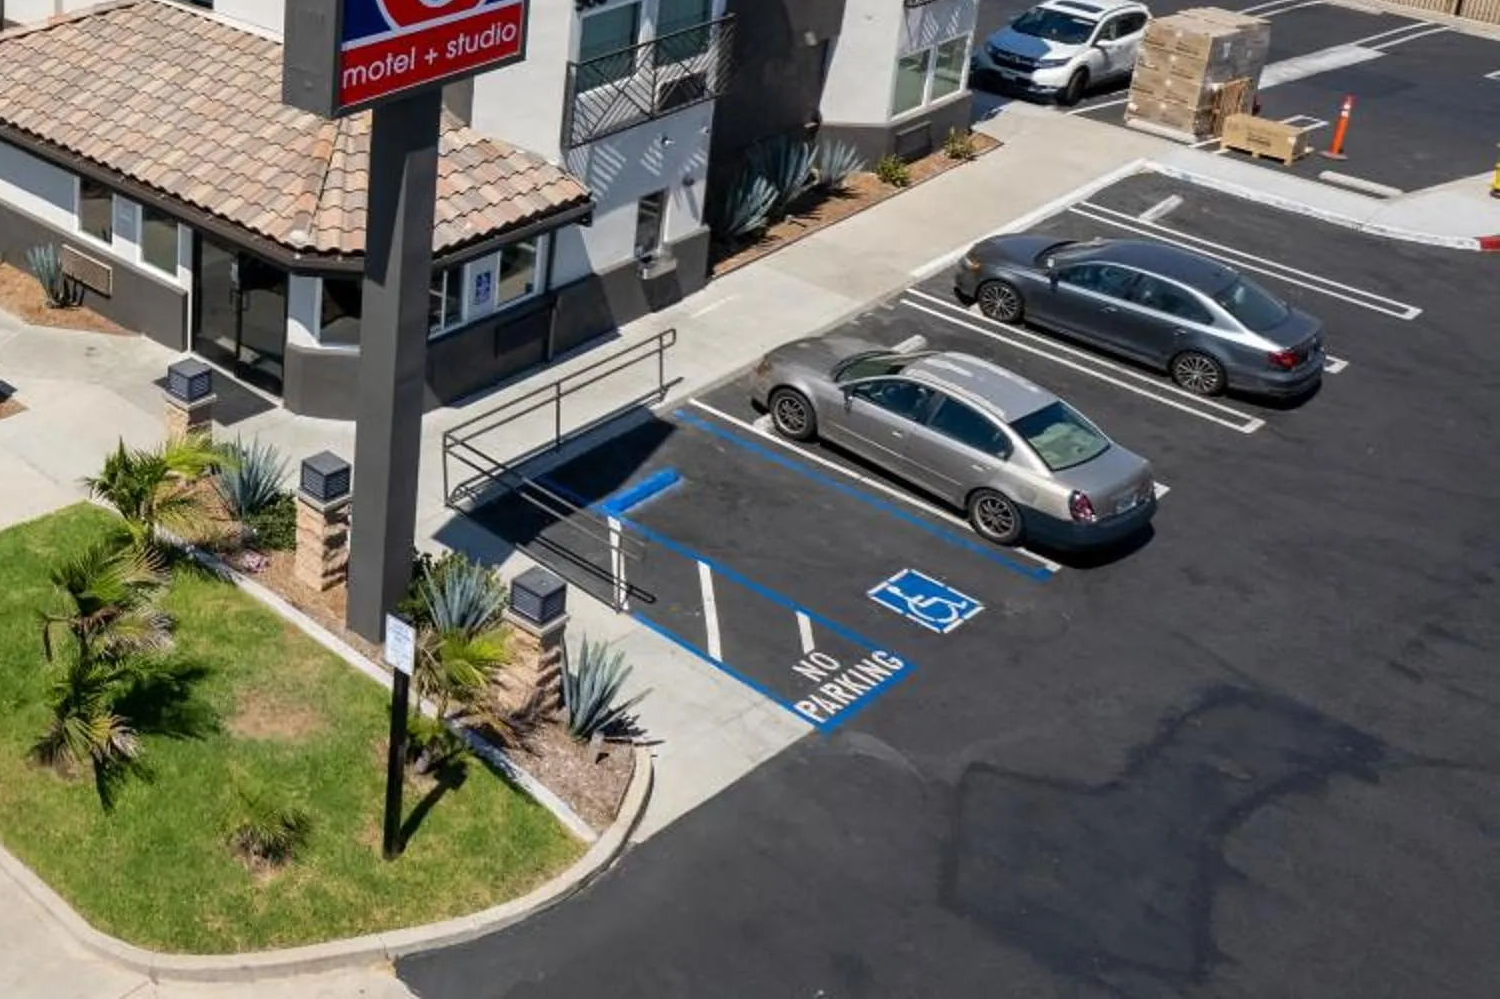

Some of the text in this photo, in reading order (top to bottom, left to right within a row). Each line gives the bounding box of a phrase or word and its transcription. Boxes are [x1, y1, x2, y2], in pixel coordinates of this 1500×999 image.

[342, 22, 517, 89] motel + studio
[791, 651, 841, 682] NO
[792, 649, 905, 724] PARKING
